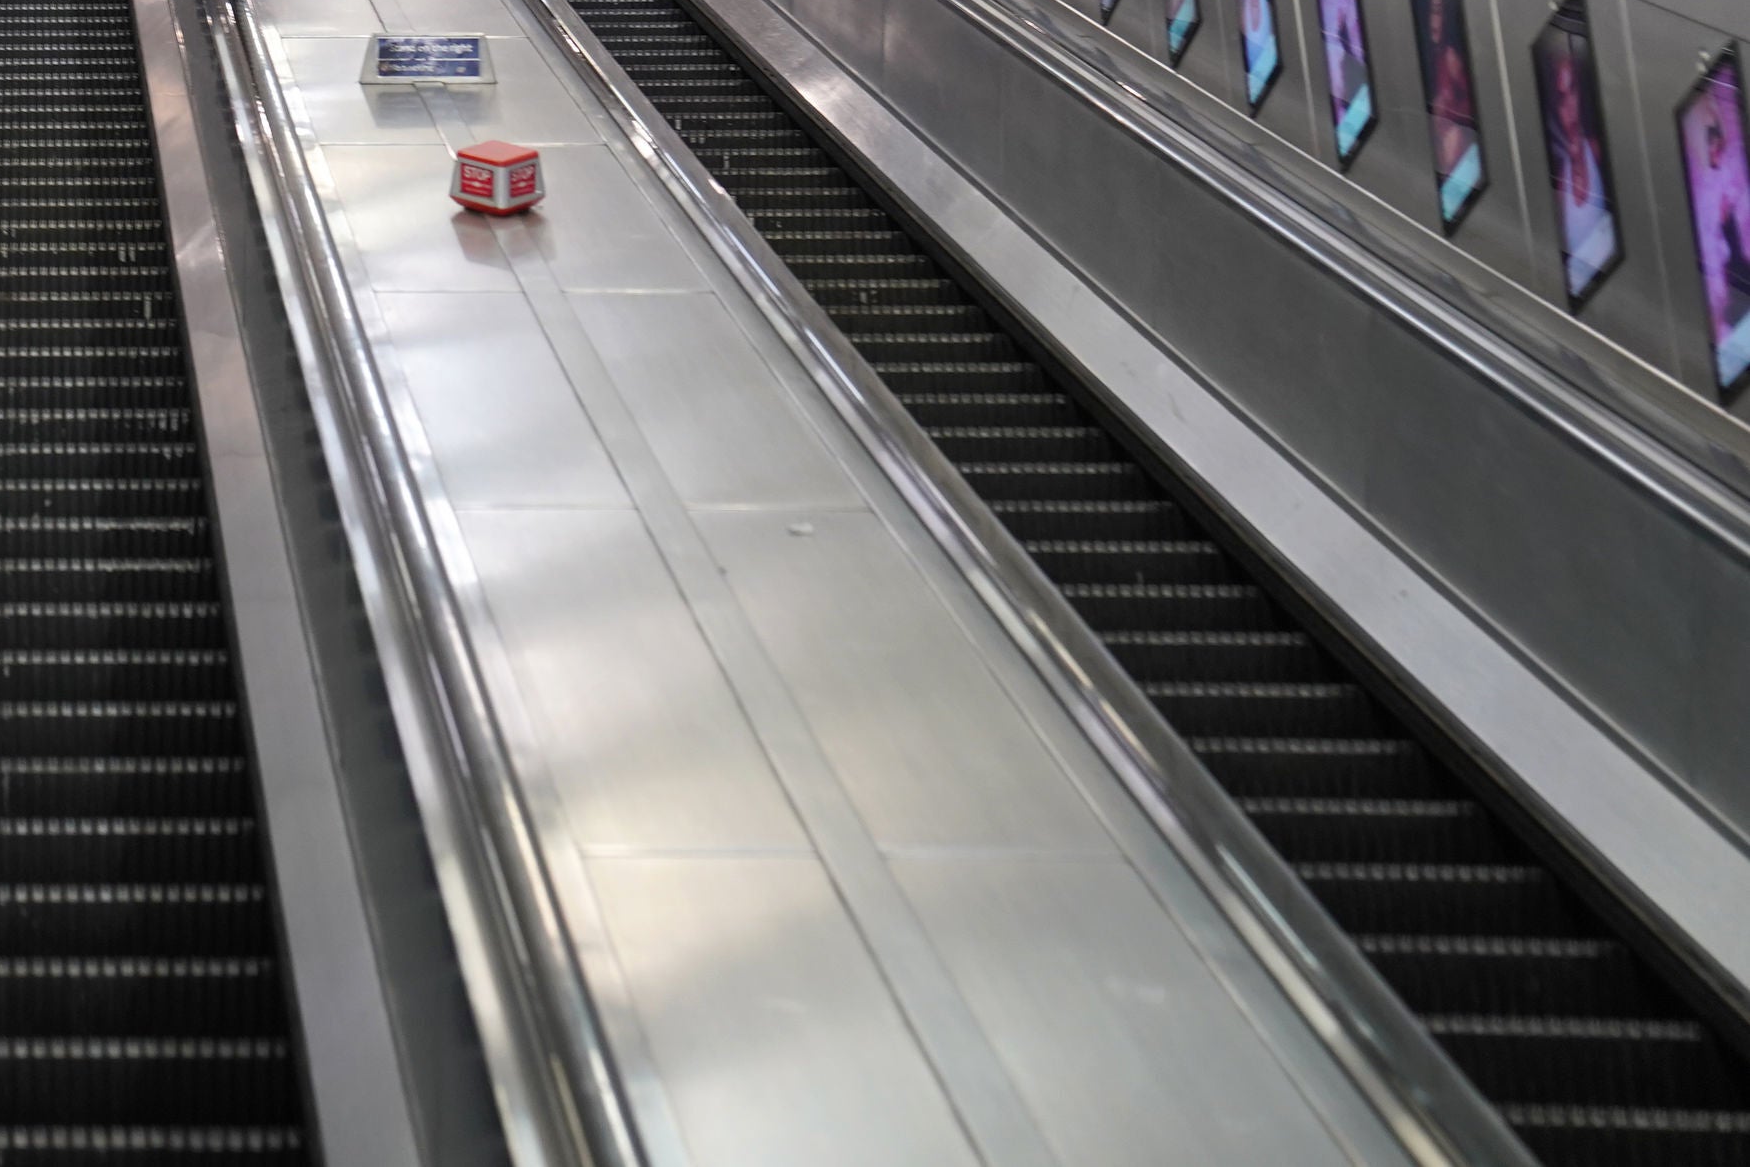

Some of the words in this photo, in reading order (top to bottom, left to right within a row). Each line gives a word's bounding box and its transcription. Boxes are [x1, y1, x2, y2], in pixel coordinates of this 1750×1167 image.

[449, 43, 474, 54] right
[463, 165, 491, 181] STOP
[511, 165, 535, 182] STOP
